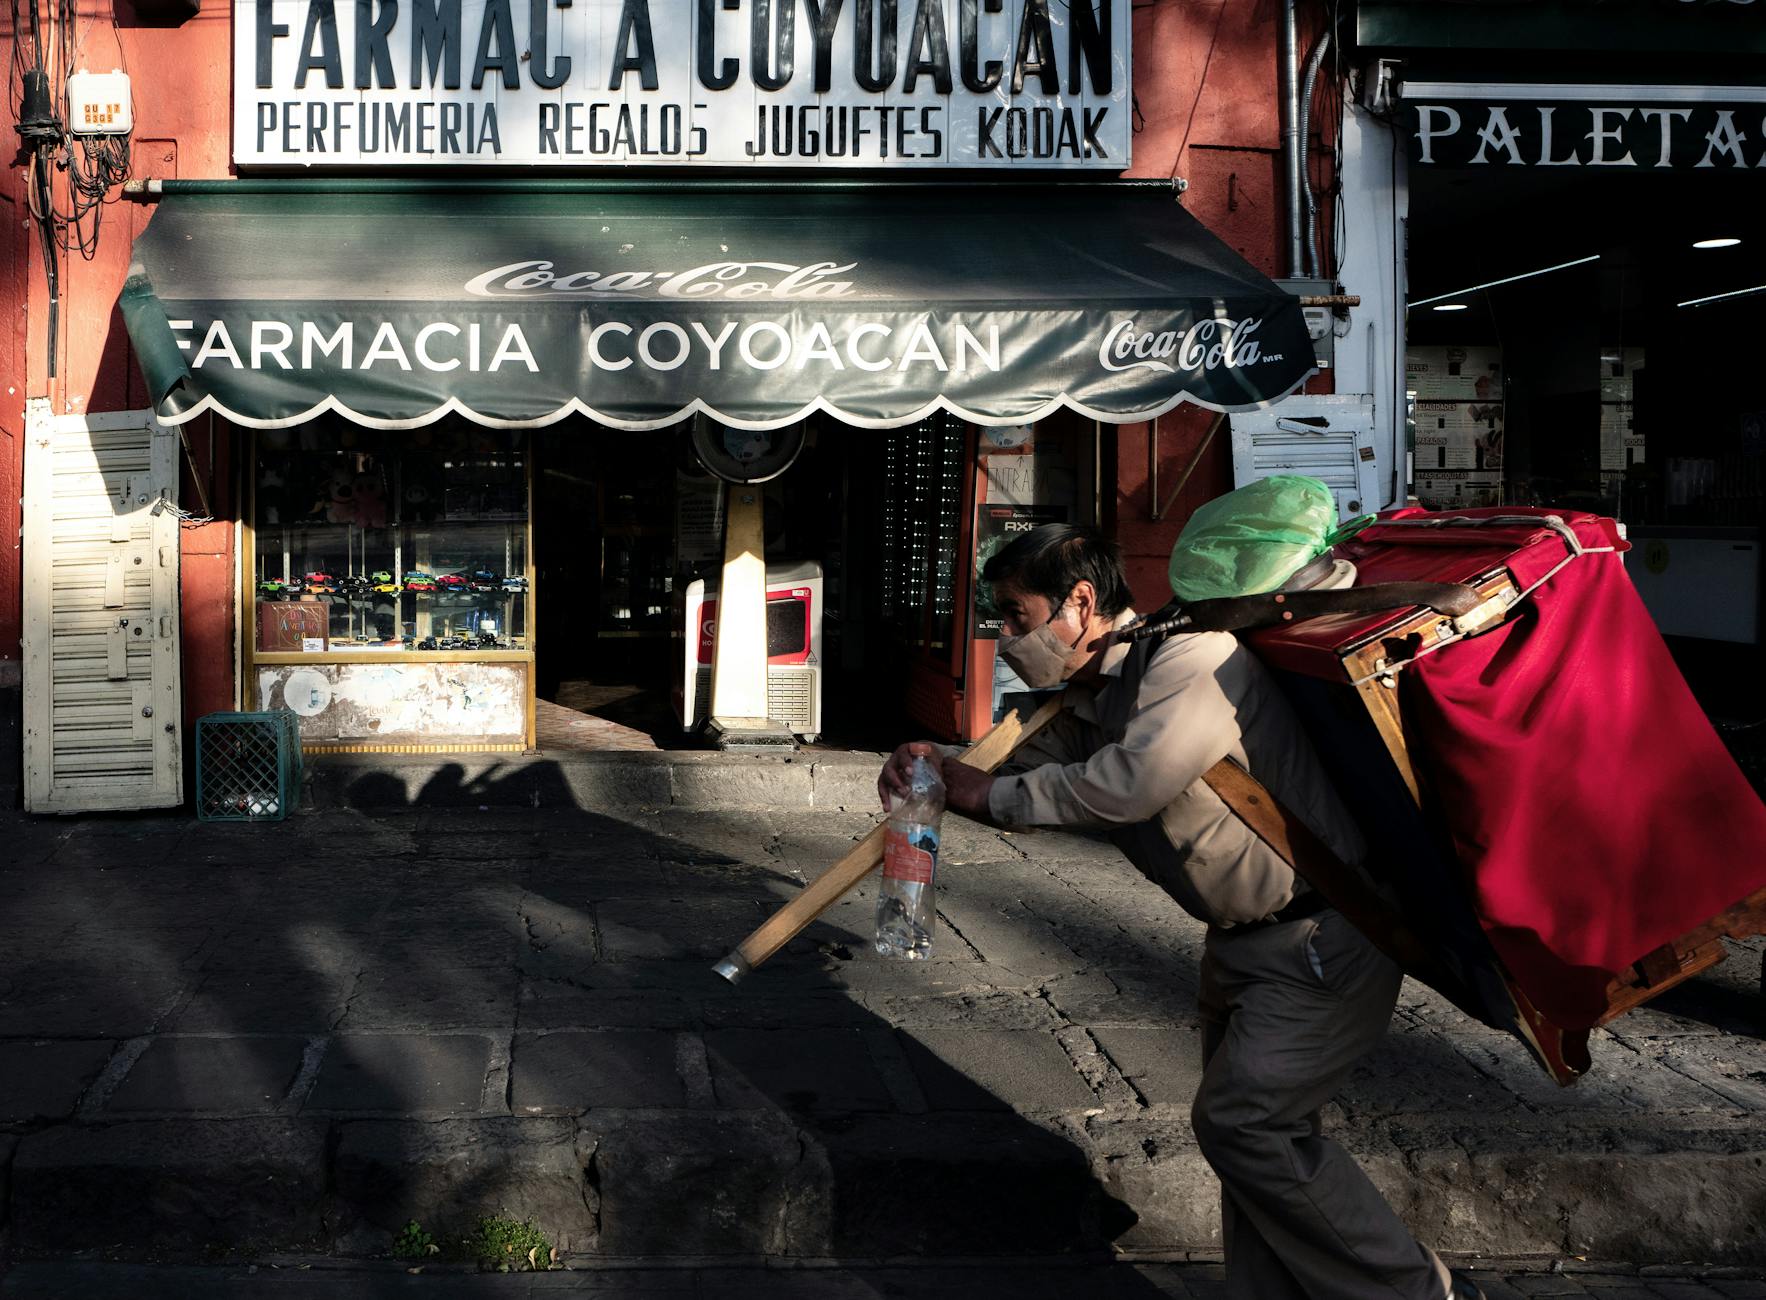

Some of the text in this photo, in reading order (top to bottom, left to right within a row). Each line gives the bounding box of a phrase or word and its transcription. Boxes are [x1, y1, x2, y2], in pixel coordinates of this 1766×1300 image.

[696, 0, 1113, 95] COYOACAN
[256, 101, 502, 154] PERFUMERIA
[977, 106, 1109, 159] KODAK
[1413, 105, 1766, 168] PALETA
[464, 260, 858, 299] Coca-Cola
[587, 320, 1001, 373] COYOACAN
[1099, 317, 1285, 373] Coca-Cola MR
